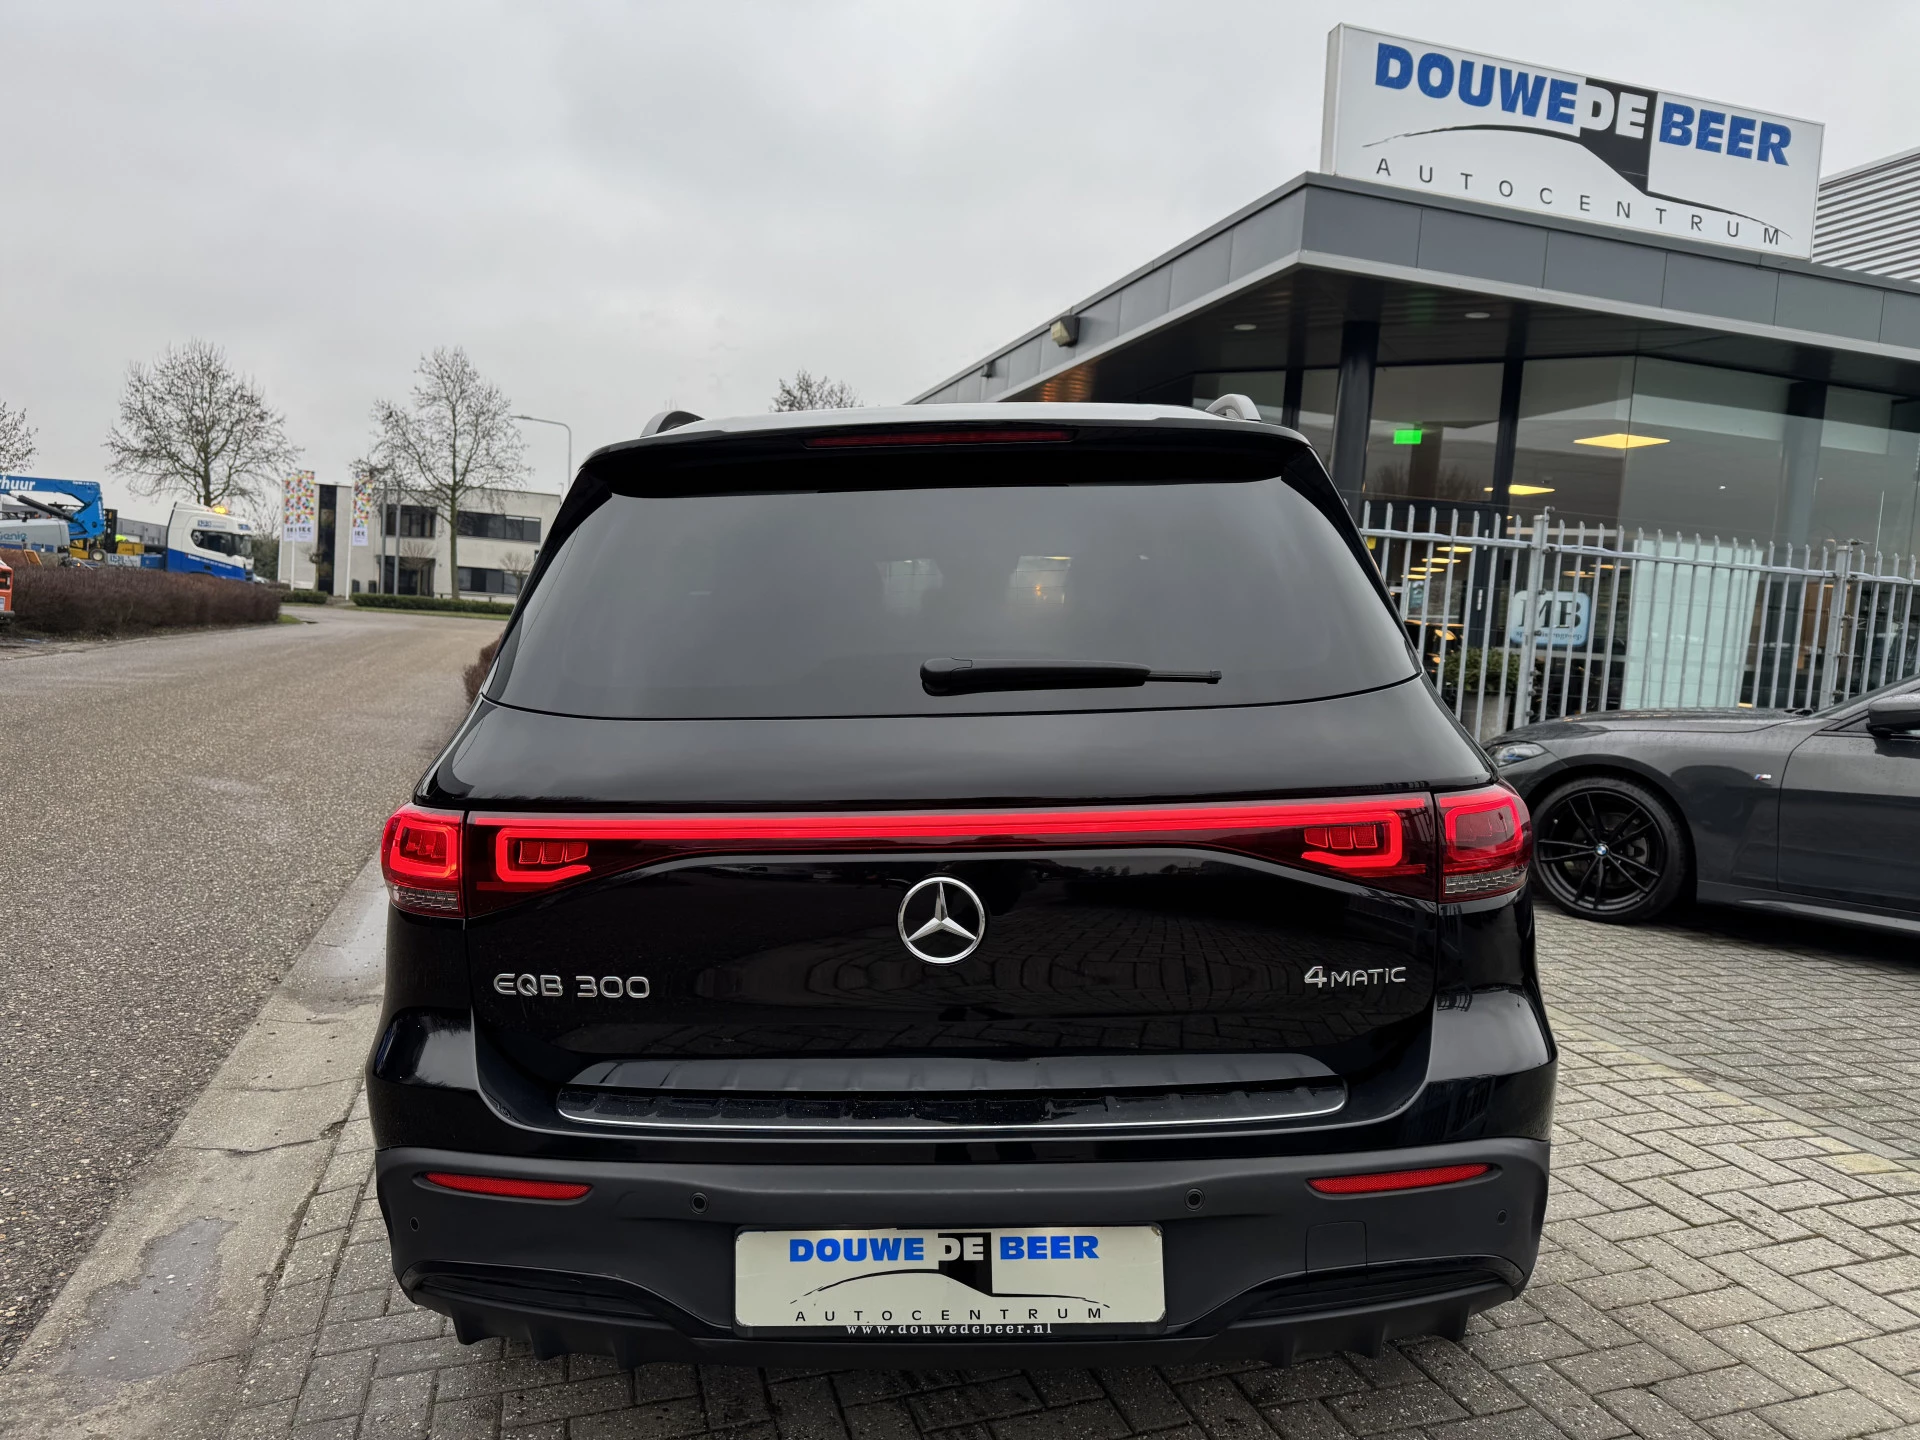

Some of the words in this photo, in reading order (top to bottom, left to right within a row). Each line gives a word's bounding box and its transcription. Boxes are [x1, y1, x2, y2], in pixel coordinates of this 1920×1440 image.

[1375, 42, 1578, 125] DOUWE
[1582, 83, 1649, 140] DE
[1658, 101, 1792, 167] BEER
[1376, 157, 1780, 246] AUTOCENTRUM
[0, 476, 36, 491] huur
[493, 973, 563, 997] EQB
[575, 975, 650, 999] 300
[789, 1237, 925, 1262] DOUWE
[937, 1236, 985, 1262] DE
[999, 1235, 1099, 1261] BEER
[795, 1307, 1101, 1322] AUTOCENTRUM
[846, 1322, 1053, 1335] www.douwedebeer.nl
